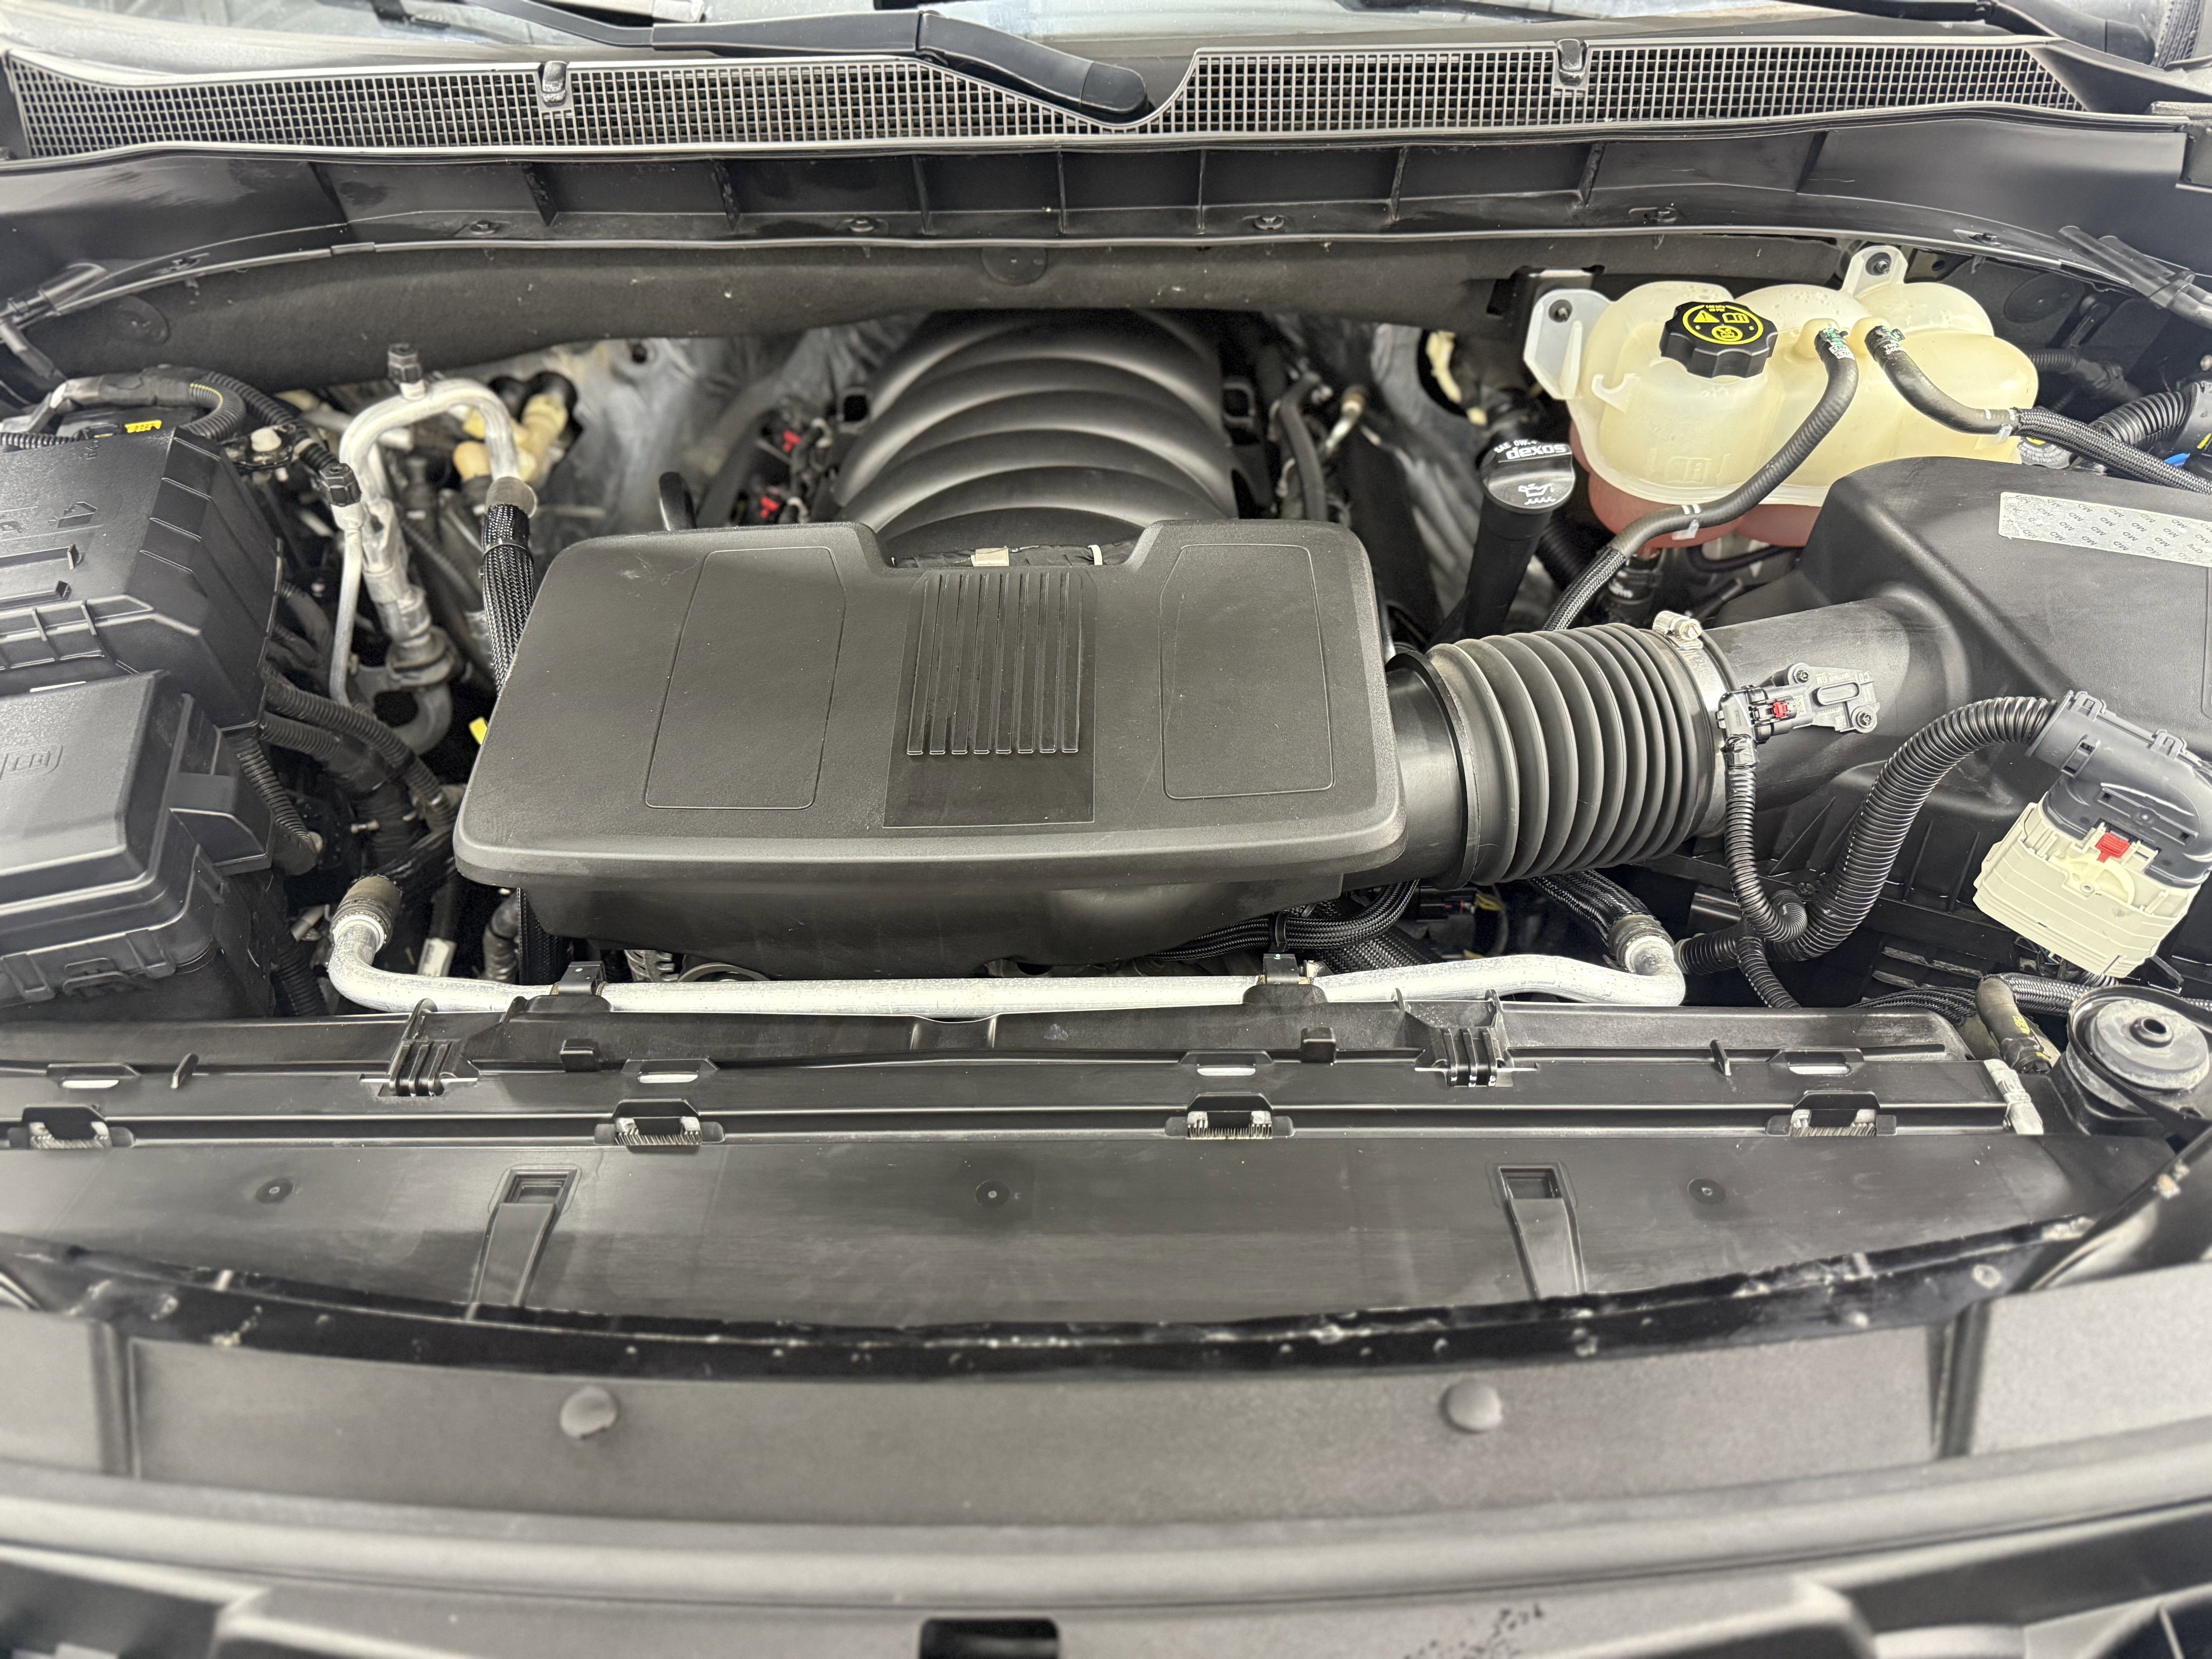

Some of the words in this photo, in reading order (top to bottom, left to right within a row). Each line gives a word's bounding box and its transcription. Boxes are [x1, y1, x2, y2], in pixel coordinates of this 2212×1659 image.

[1494, 441, 1512, 453] SAE
[1506, 445, 1566, 460] dexos
[1816, 675, 1826, 685] GM
